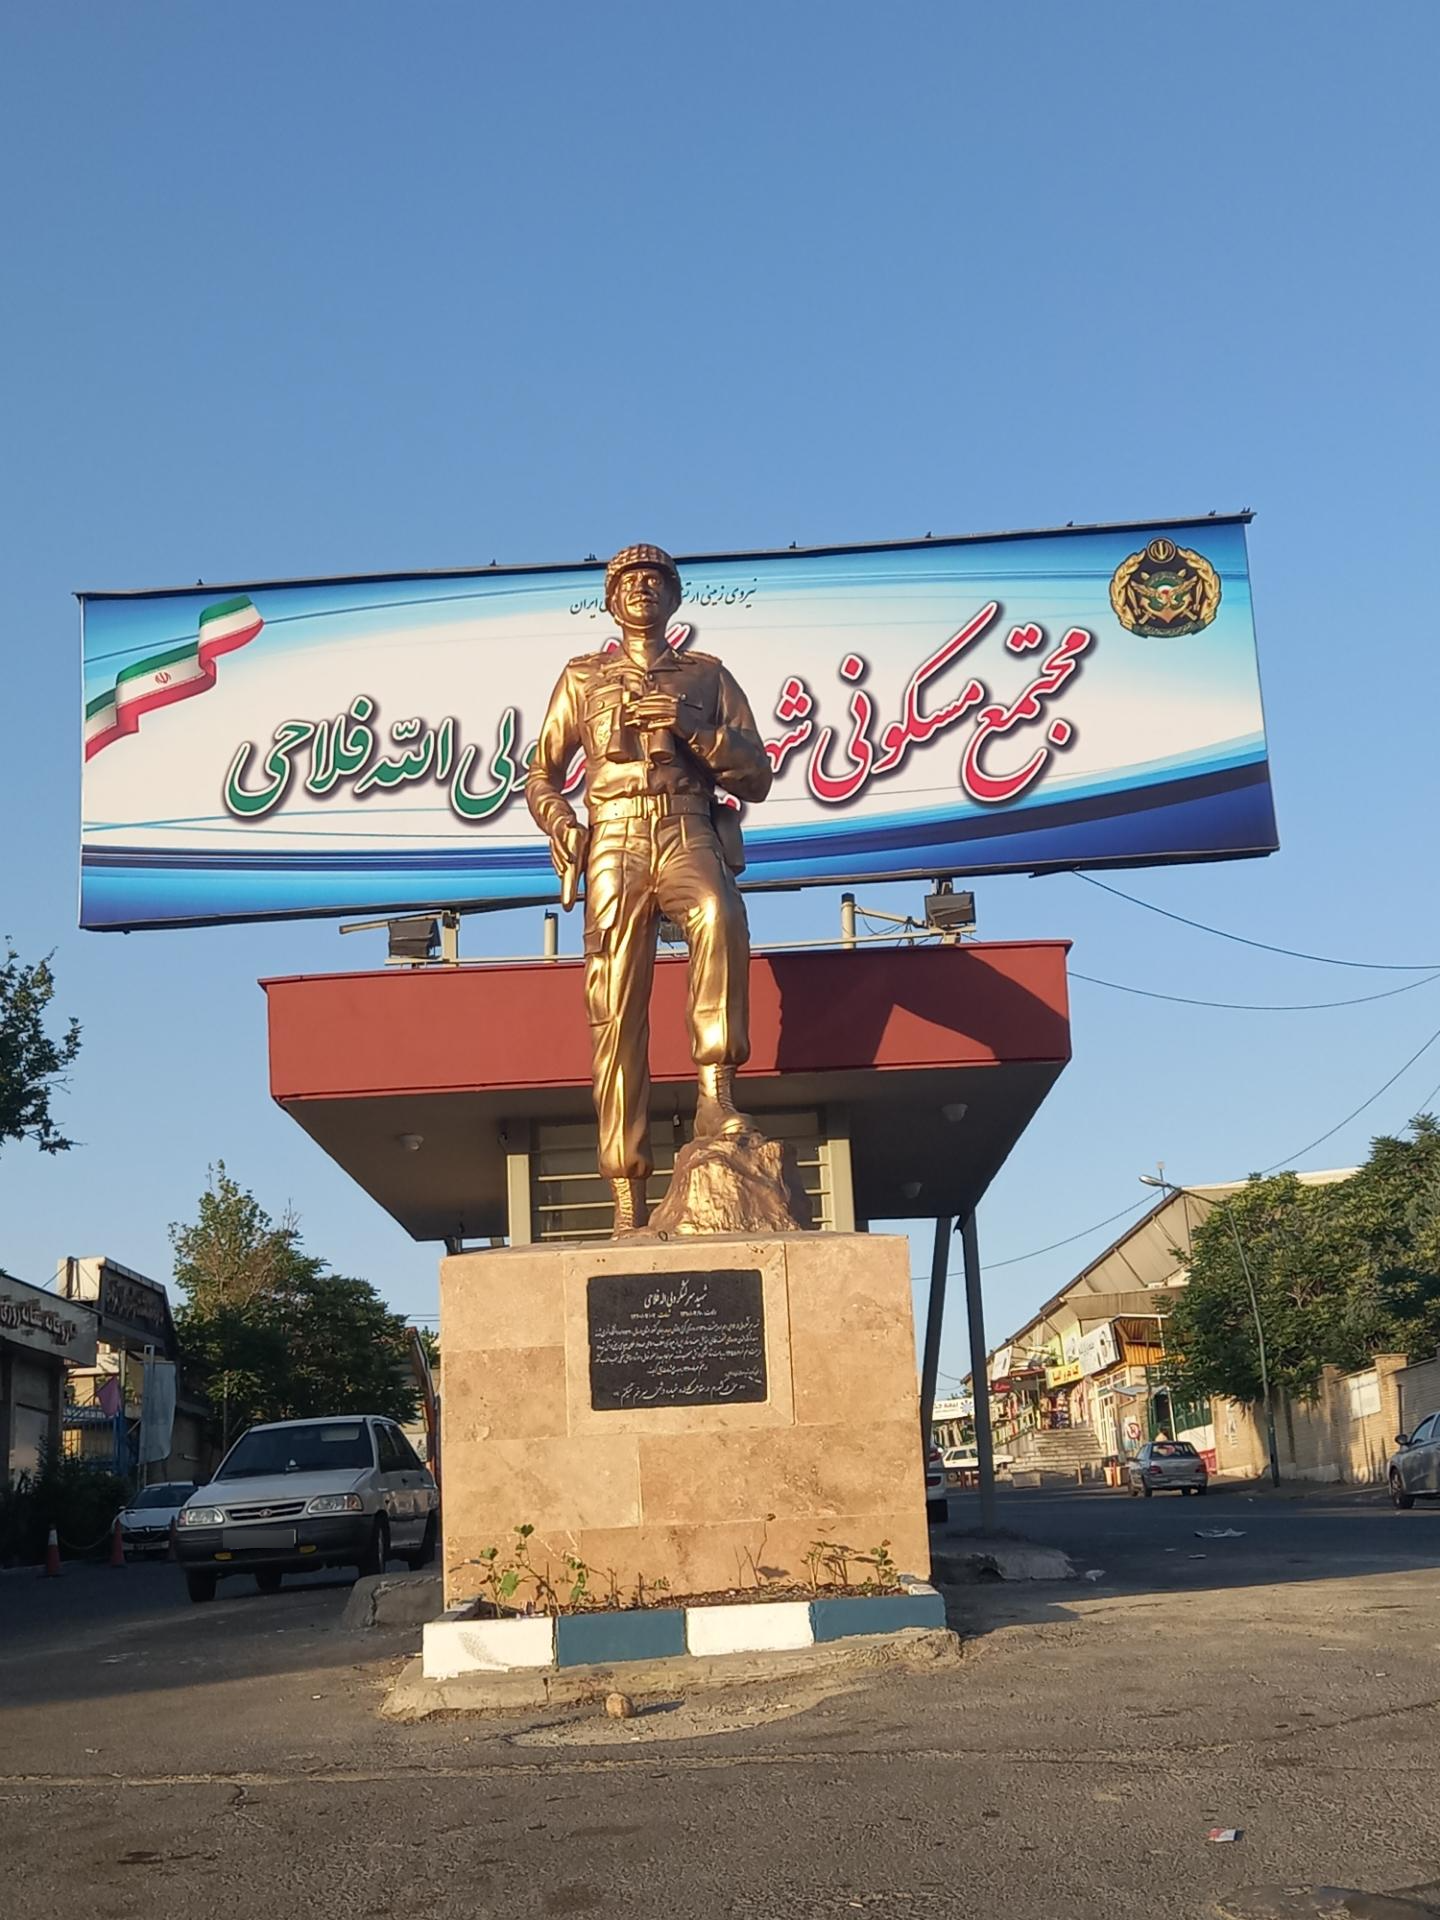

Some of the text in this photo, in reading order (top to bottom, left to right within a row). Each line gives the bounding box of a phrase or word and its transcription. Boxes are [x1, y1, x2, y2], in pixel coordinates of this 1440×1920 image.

[569, 597, 598, 618] ایران
[700, 585, 725, 606] زمینی
[725, 578, 758, 608] نیروی
[809, 601, 999, 802] مسکونی
[962, 624, 1090, 801] مجتمع
[224, 694, 375, 816] فلاحی
